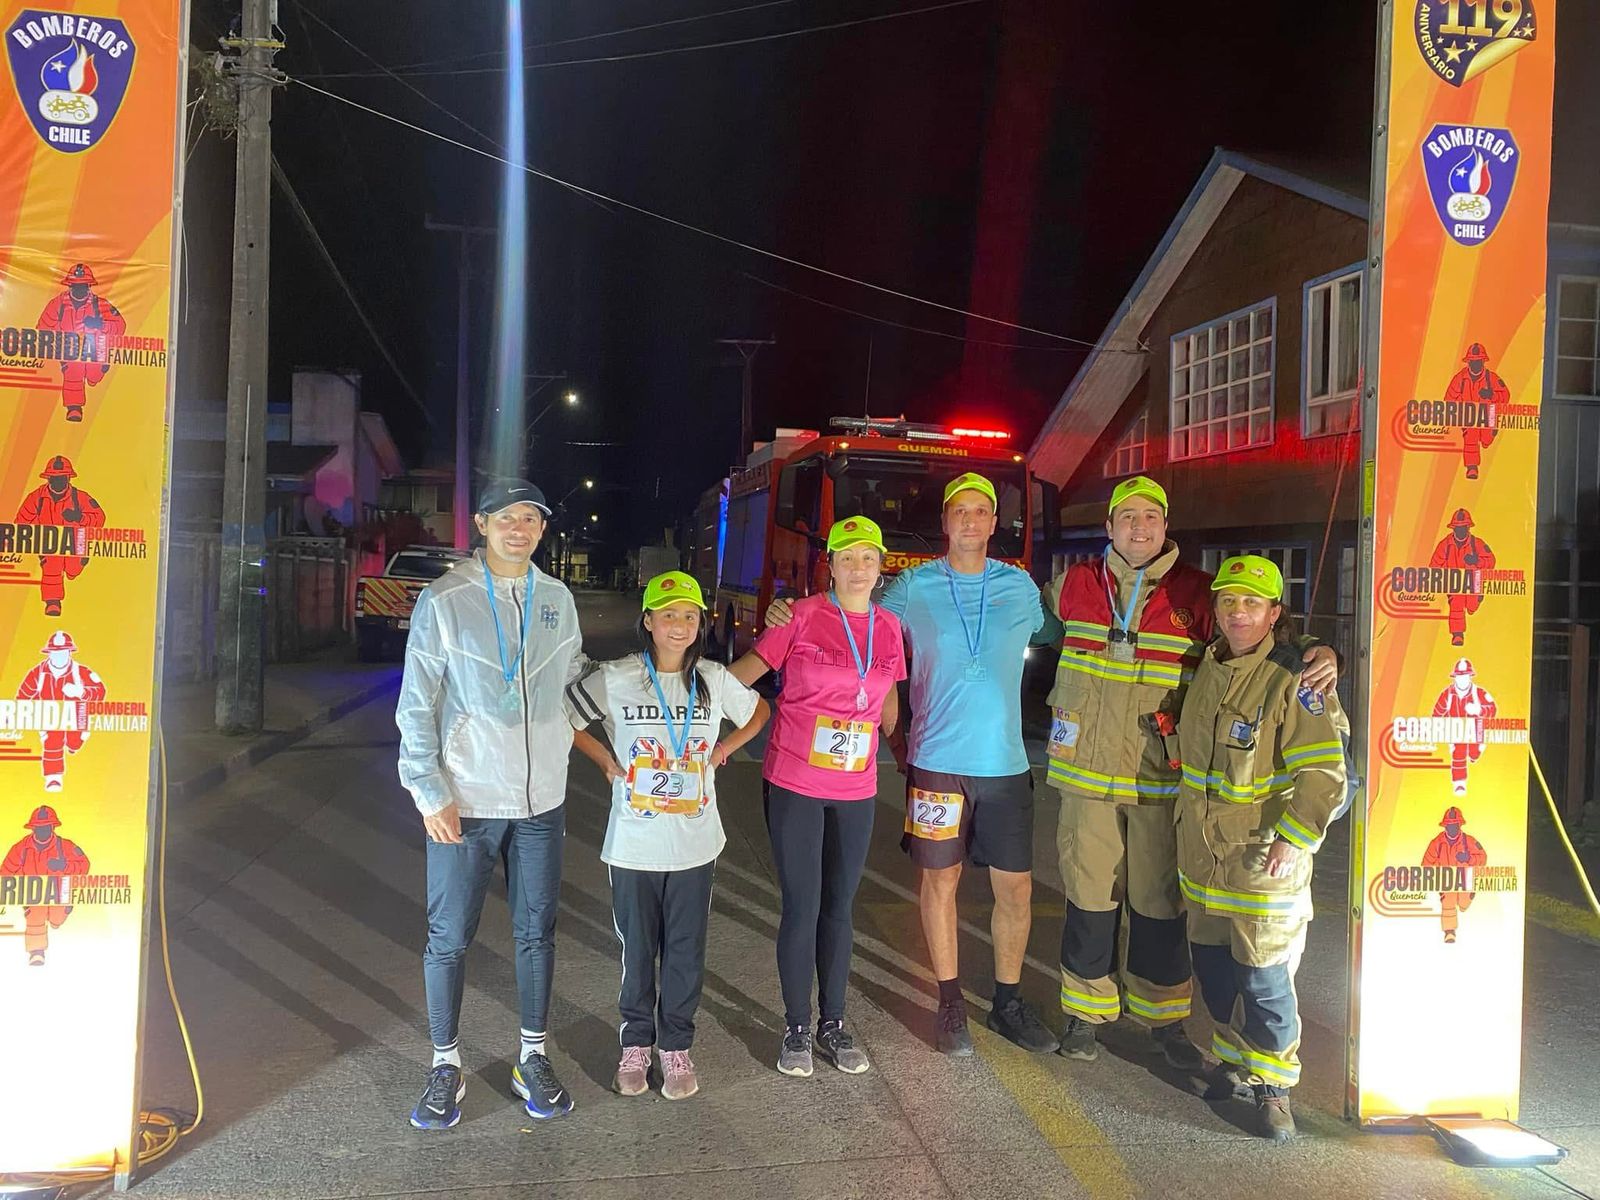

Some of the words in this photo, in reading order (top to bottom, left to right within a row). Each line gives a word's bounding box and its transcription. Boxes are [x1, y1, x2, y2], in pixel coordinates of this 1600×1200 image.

[1439, 0, 1522, 38] 119
[12, 15, 128, 58] BOMBEROS
[1420, 3, 1455, 79] ANIVERSARIO
[49, 126, 90, 145] CHILE
[1427, 128, 1514, 163] BOMBEROS
[1454, 223, 1485, 239] CHILE
[0, 327, 97, 362] ORRIDA
[108, 335, 166, 351] BOMBERIL
[0, 358, 44, 369] uemchi
[108, 349, 166, 367] FAMILIAR
[1407, 400, 1489, 427] CORRIDA
[1413, 424, 1451, 435] Quemchi
[898, 444, 968, 456] QUEMCHI
[86, 526, 146, 543] BOMBERIL
[87, 541, 146, 558] FAMILIAR
[1391, 567, 1474, 594] CORRIDA
[1482, 569, 1526, 581] BOMBERIL
[1482, 580, 1526, 596] FAMILIAR
[1398, 592, 1436, 602] Quemchi
[88, 701, 148, 716] BOMBERIL
[88, 714, 148, 732] FAMILIAR
[1393, 716, 1477, 744] CORRIDA
[1484, 719, 1528, 730] BOMBERIL
[651, 771, 684, 797] 23
[917, 802, 947, 826] 22
[1383, 866, 1466, 892] CORRIDA
[1474, 866, 1517, 878] BOMBERIL
[70, 874, 131, 889] BOMBERIL
[1474, 878, 1518, 892] FAMILIAR
[71, 888, 131, 905] FAMILIAR
[1390, 891, 1427, 901] Quemchi
